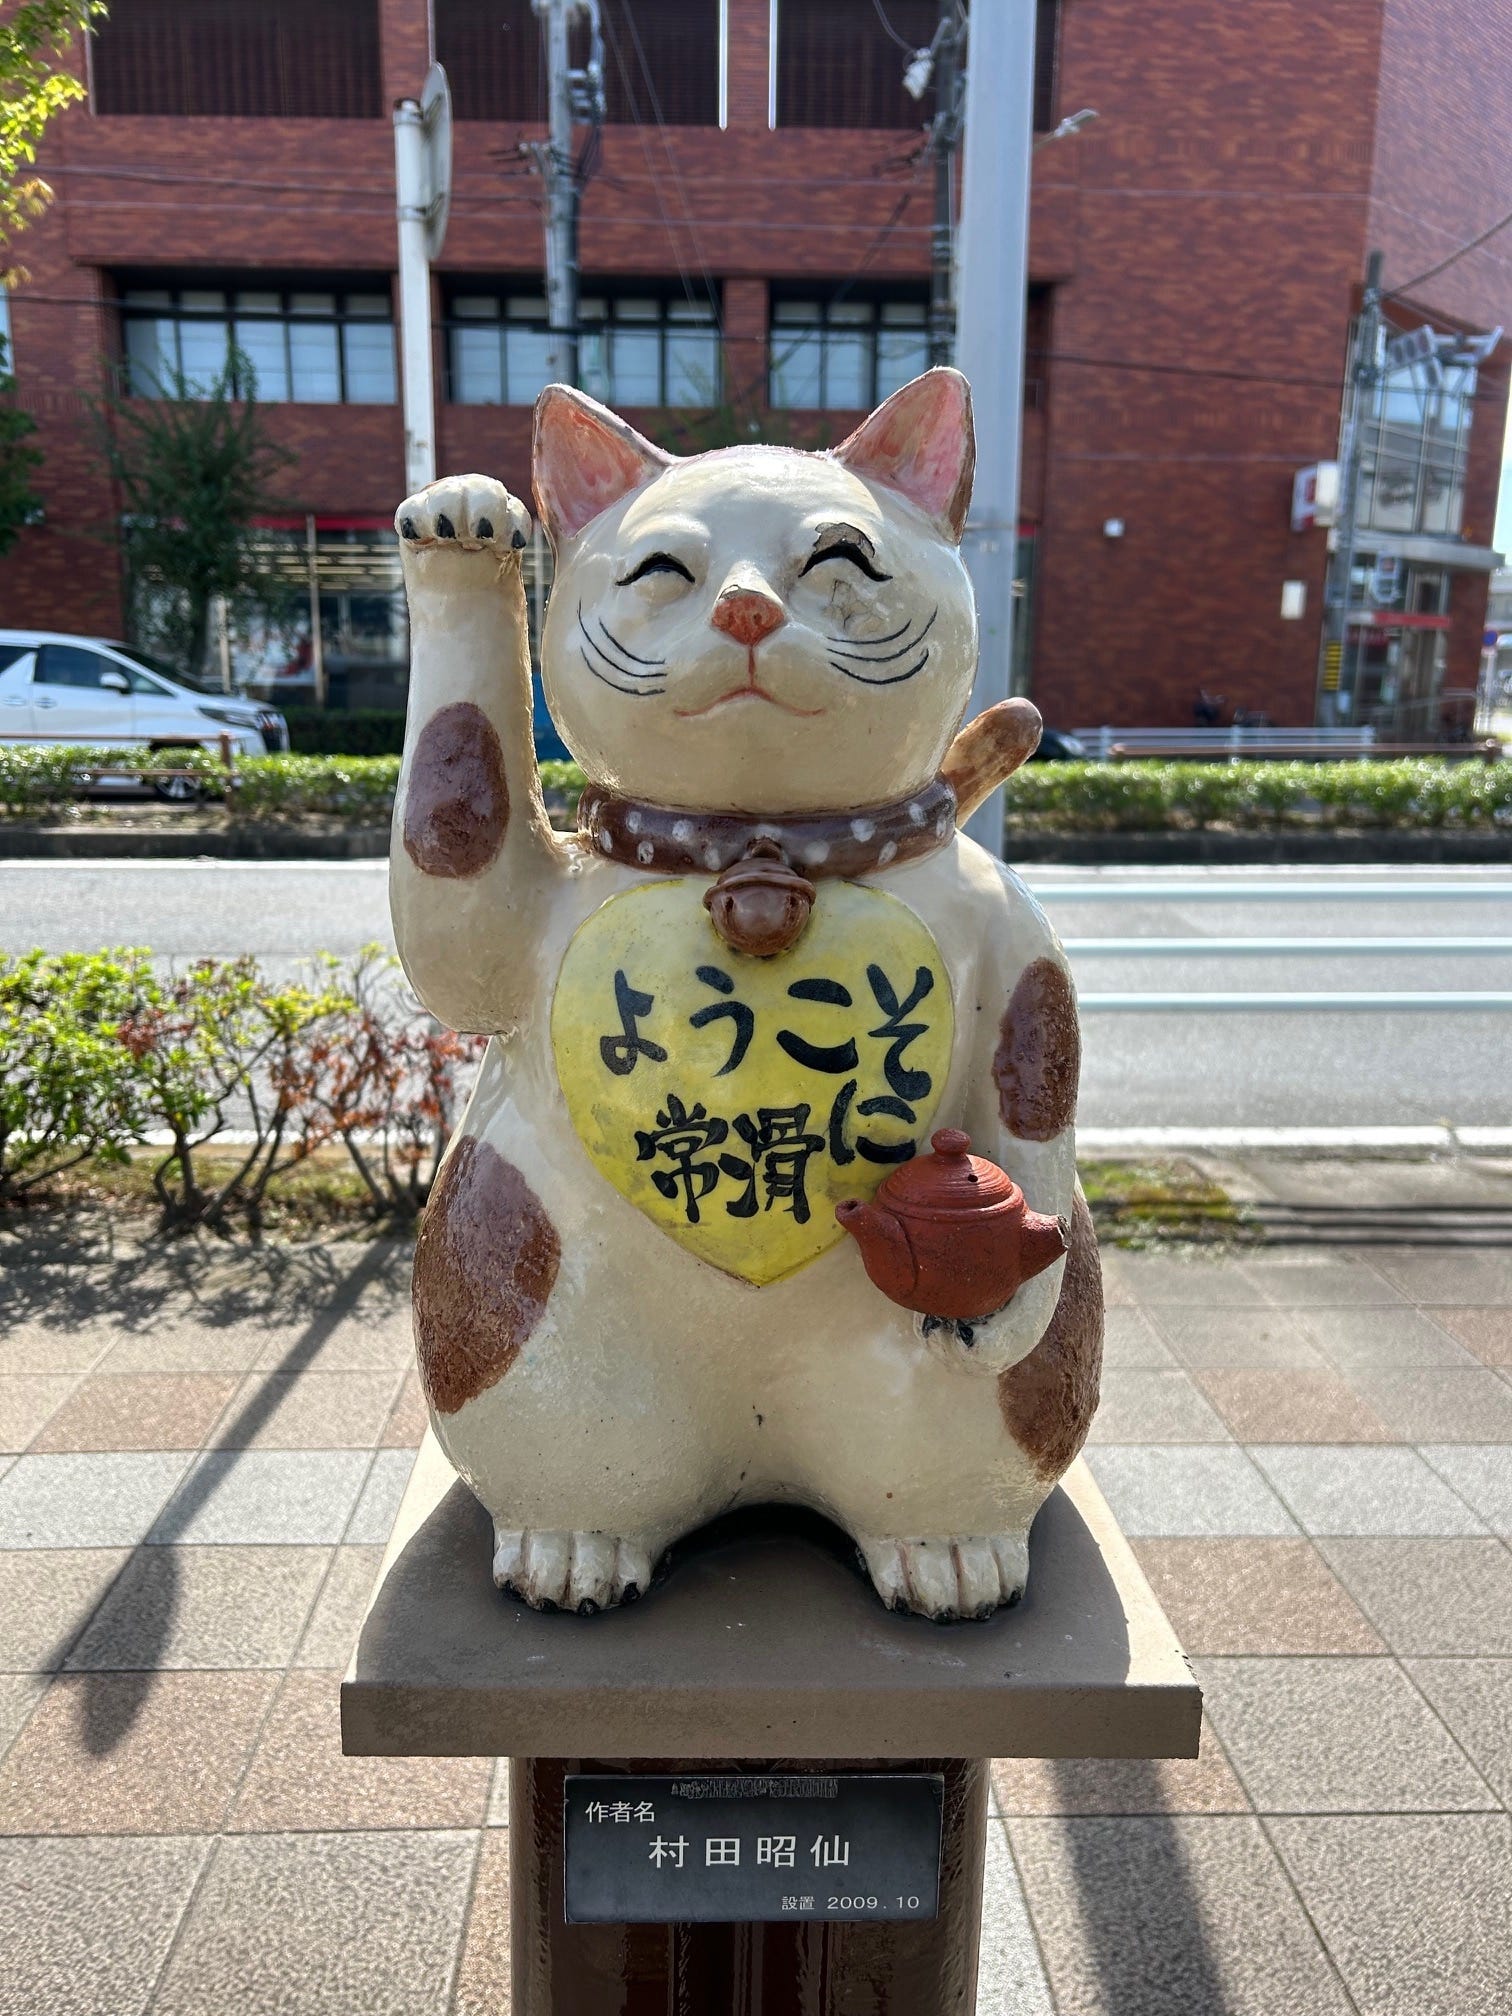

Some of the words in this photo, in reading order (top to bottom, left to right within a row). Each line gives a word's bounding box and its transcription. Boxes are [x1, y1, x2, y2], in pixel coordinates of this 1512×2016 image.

[600, 963, 935, 1101] ようこそ
[634, 1079, 918, 1224] 常滑に
[585, 1800, 656, 1824] 作者名
[648, 1834, 850, 1869] 村田昭仙
[781, 1896, 815, 1911] 設置
